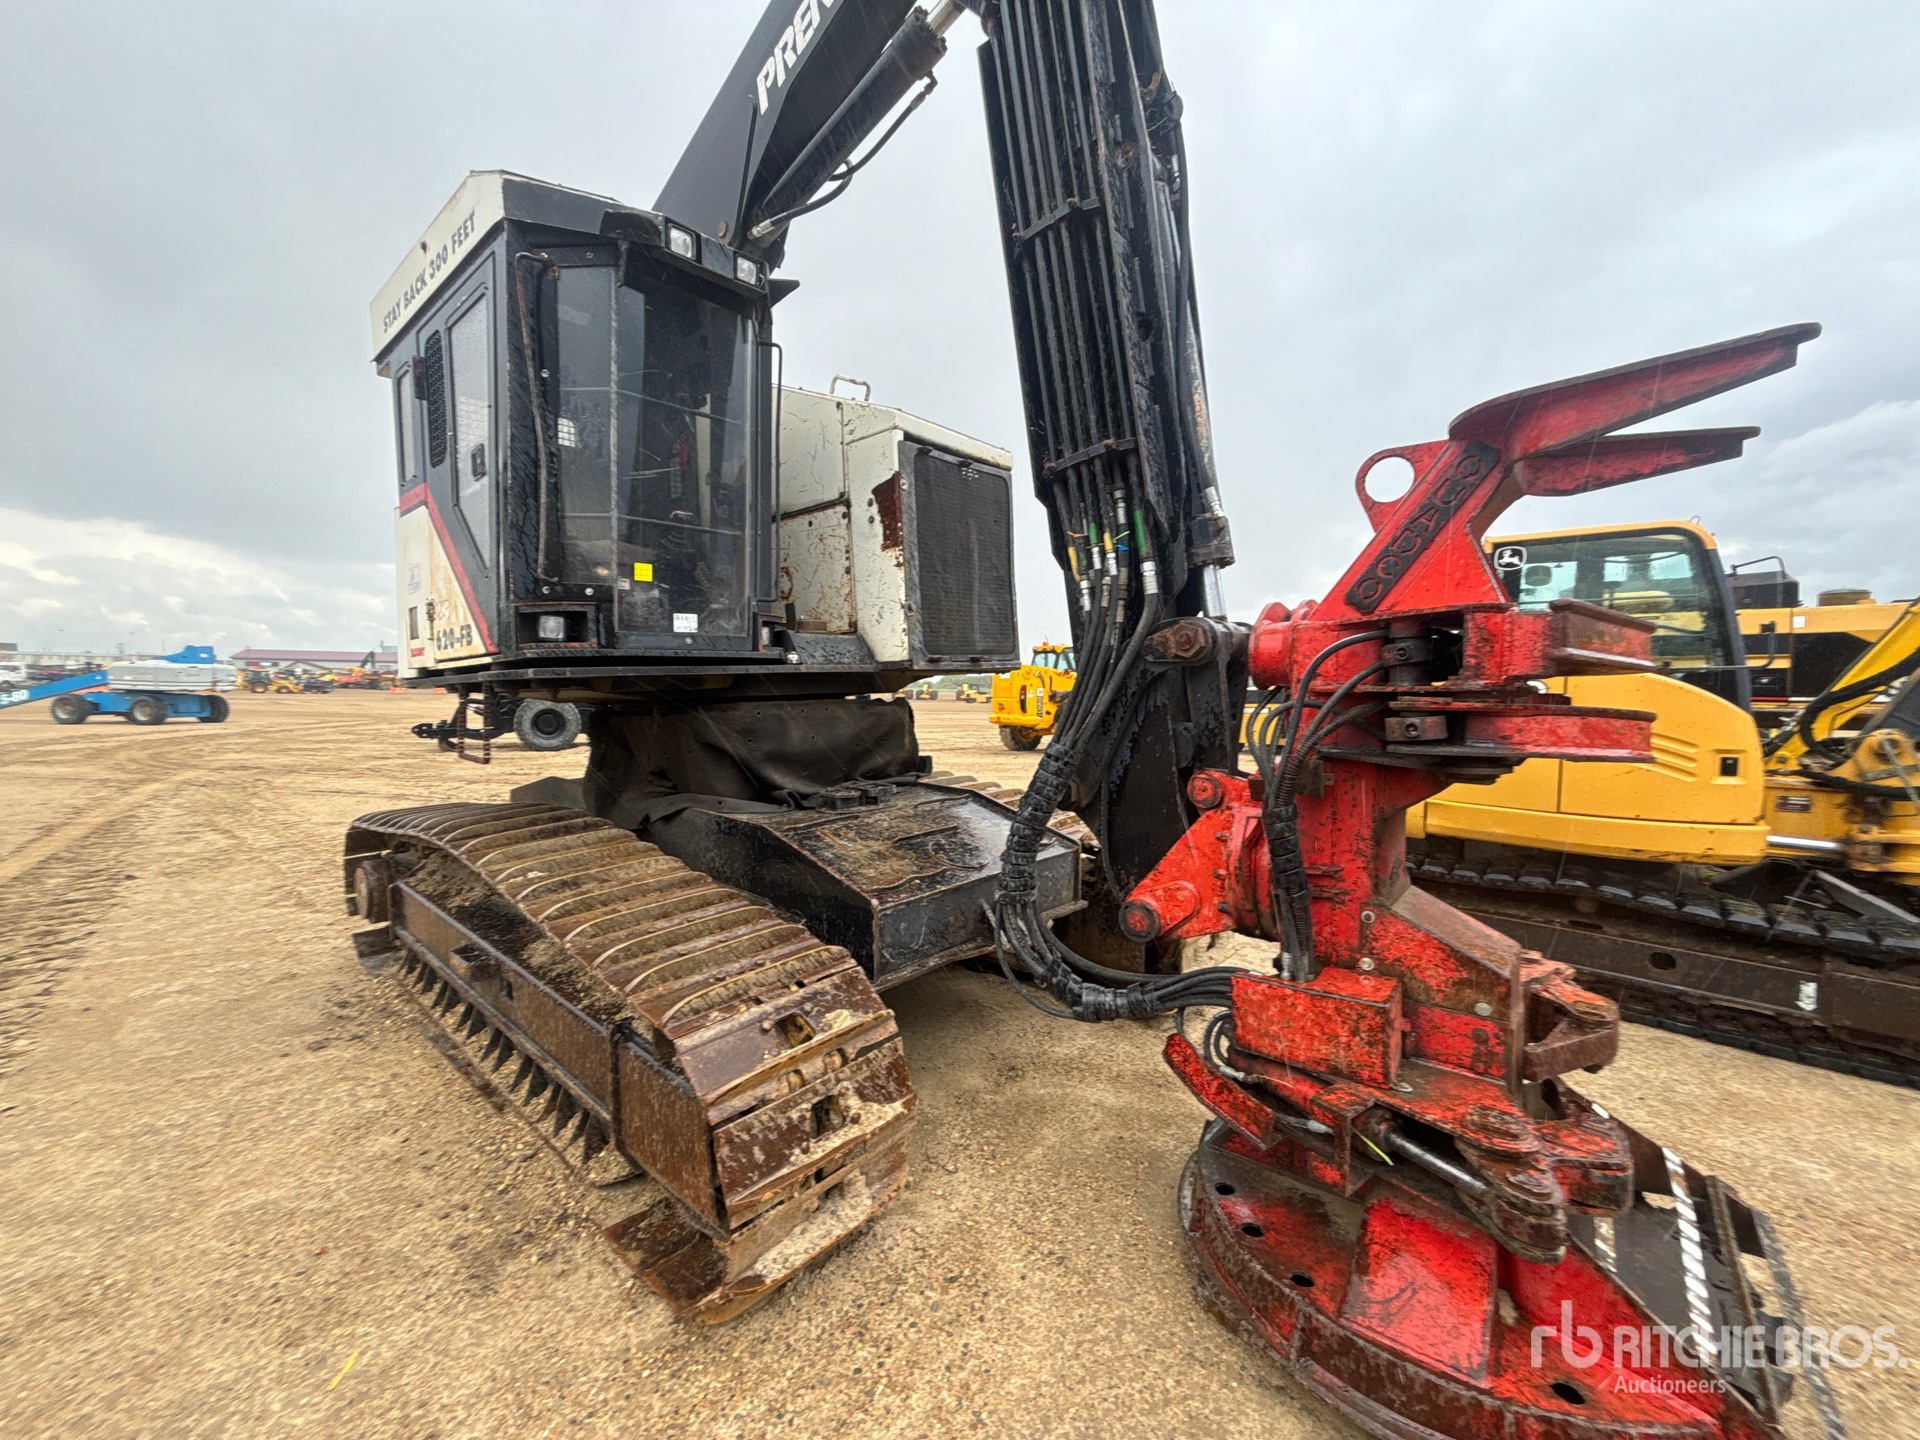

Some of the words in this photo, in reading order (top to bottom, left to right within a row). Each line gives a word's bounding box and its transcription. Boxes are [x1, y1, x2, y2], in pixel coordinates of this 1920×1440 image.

[383, 297, 401, 334] STAY
[403, 267, 427, 310] BACK
[429, 244, 448, 280] 300
[451, 210, 475, 255] FEET
[436, 623, 473, 651] 620-FB
